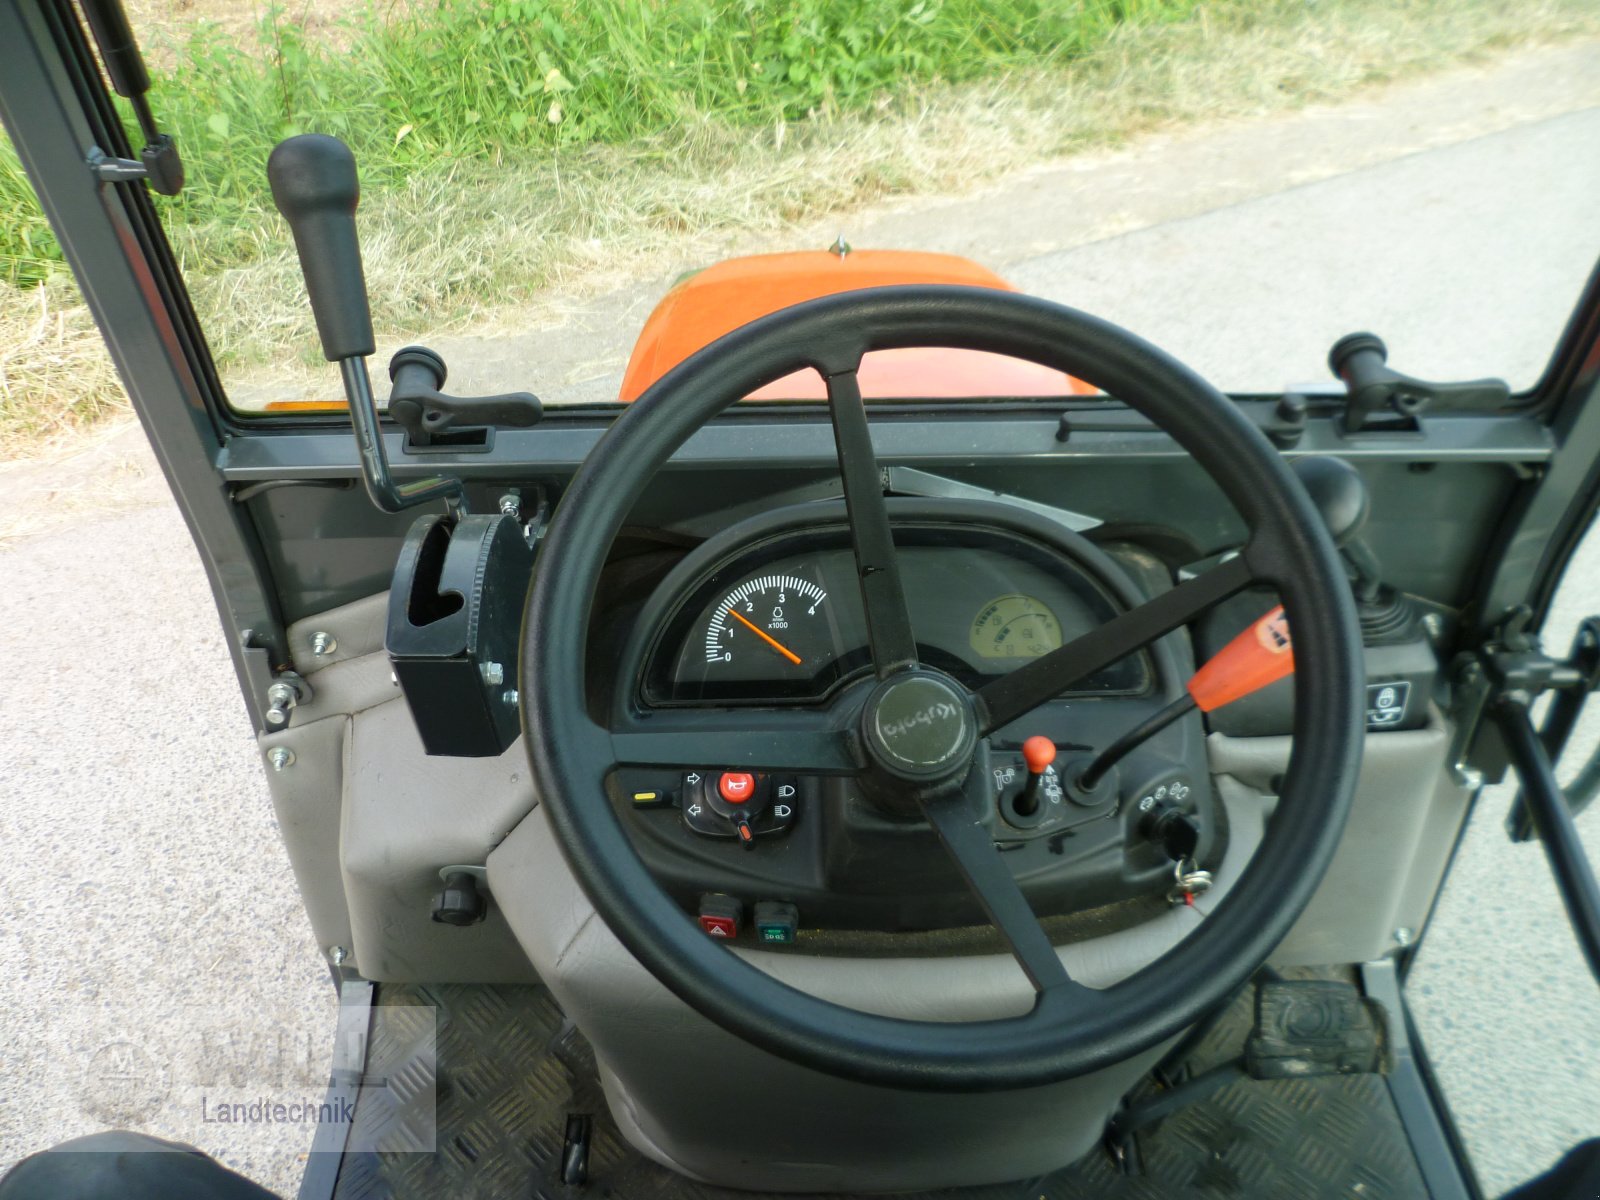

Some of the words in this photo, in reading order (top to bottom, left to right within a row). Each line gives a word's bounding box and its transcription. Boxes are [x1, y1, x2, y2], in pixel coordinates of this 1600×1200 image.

[778, 593, 786, 603] 3
[746, 602, 754, 612] 2
[807, 605, 816, 615] 4
[767, 621, 789, 630] x1000
[728, 629, 734, 638] 1
[724, 652, 732, 662] 0
[882, 703, 958, 735] Kubota
